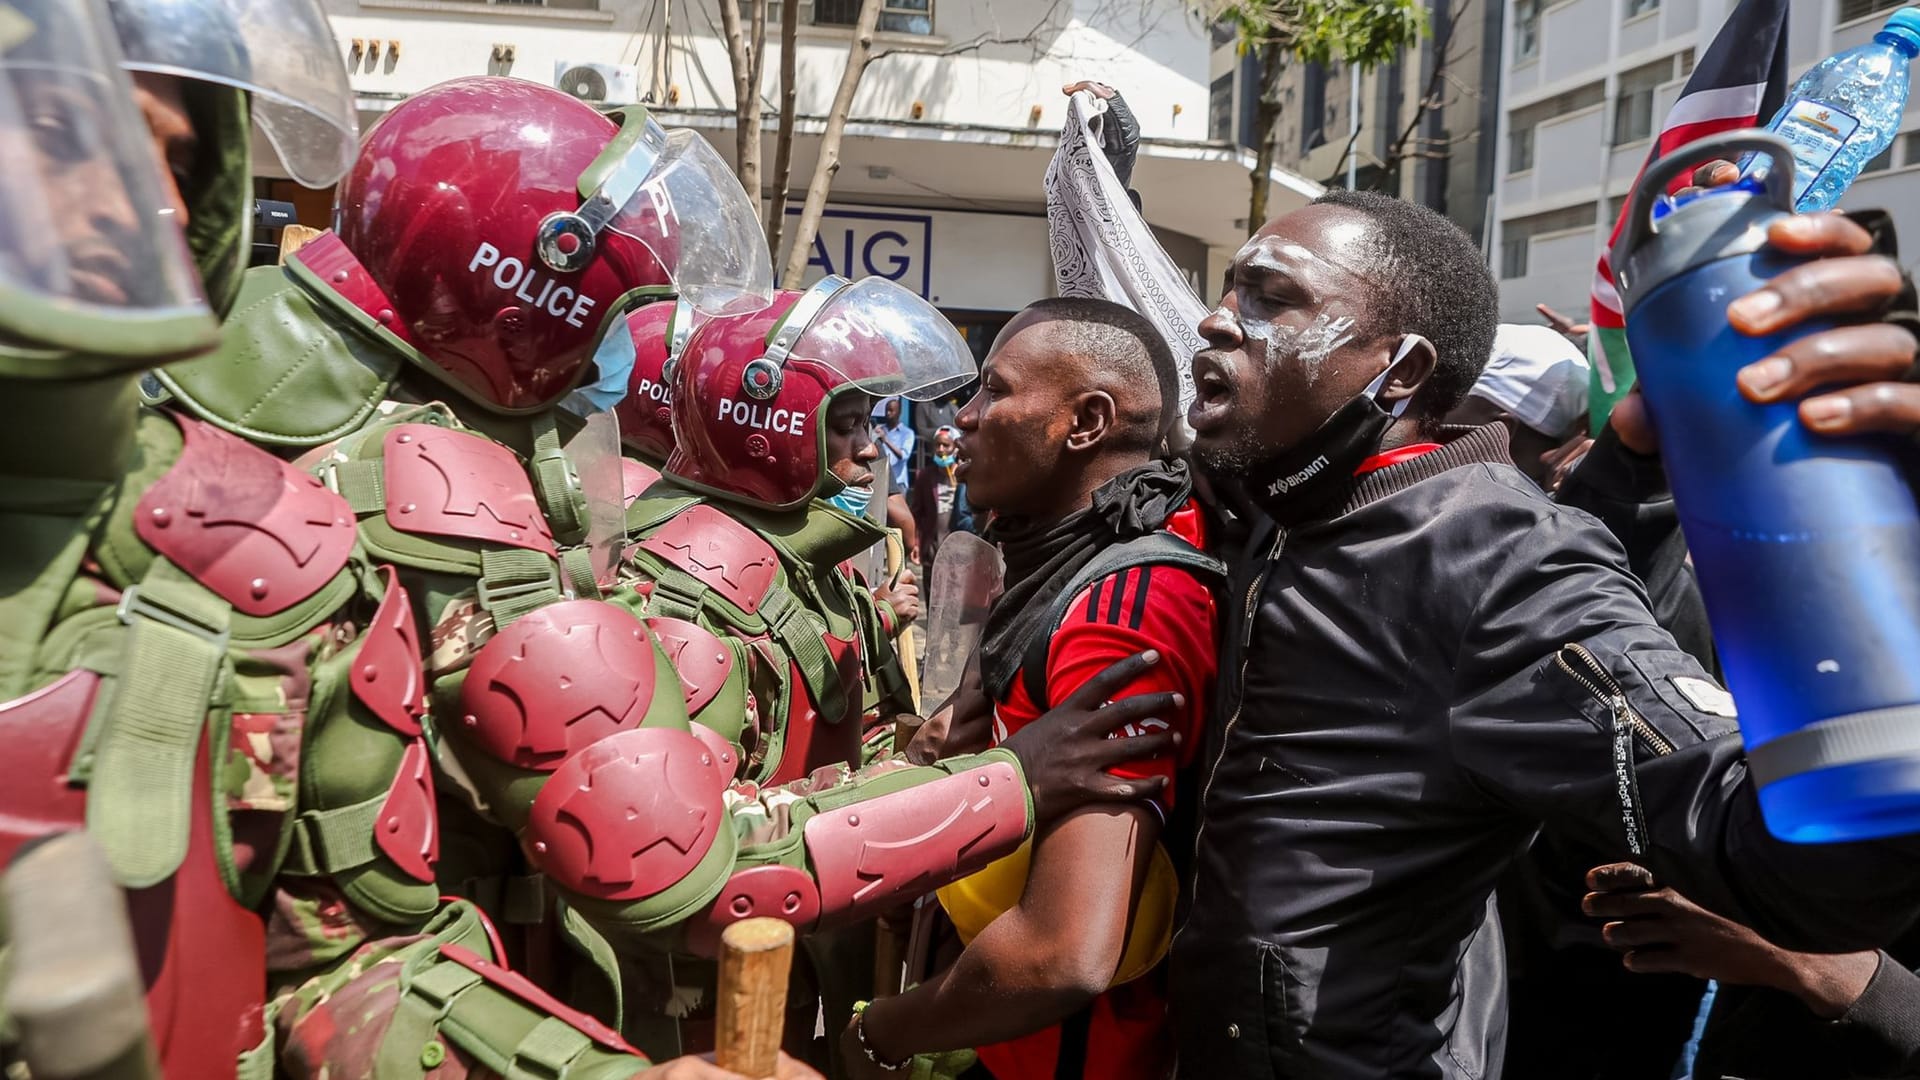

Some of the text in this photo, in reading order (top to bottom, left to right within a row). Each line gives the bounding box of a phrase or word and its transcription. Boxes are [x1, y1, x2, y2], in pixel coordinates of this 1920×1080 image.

[808, 229, 910, 281] AIG
[468, 242, 596, 328] POLICE
[717, 398, 806, 436] POLICE
